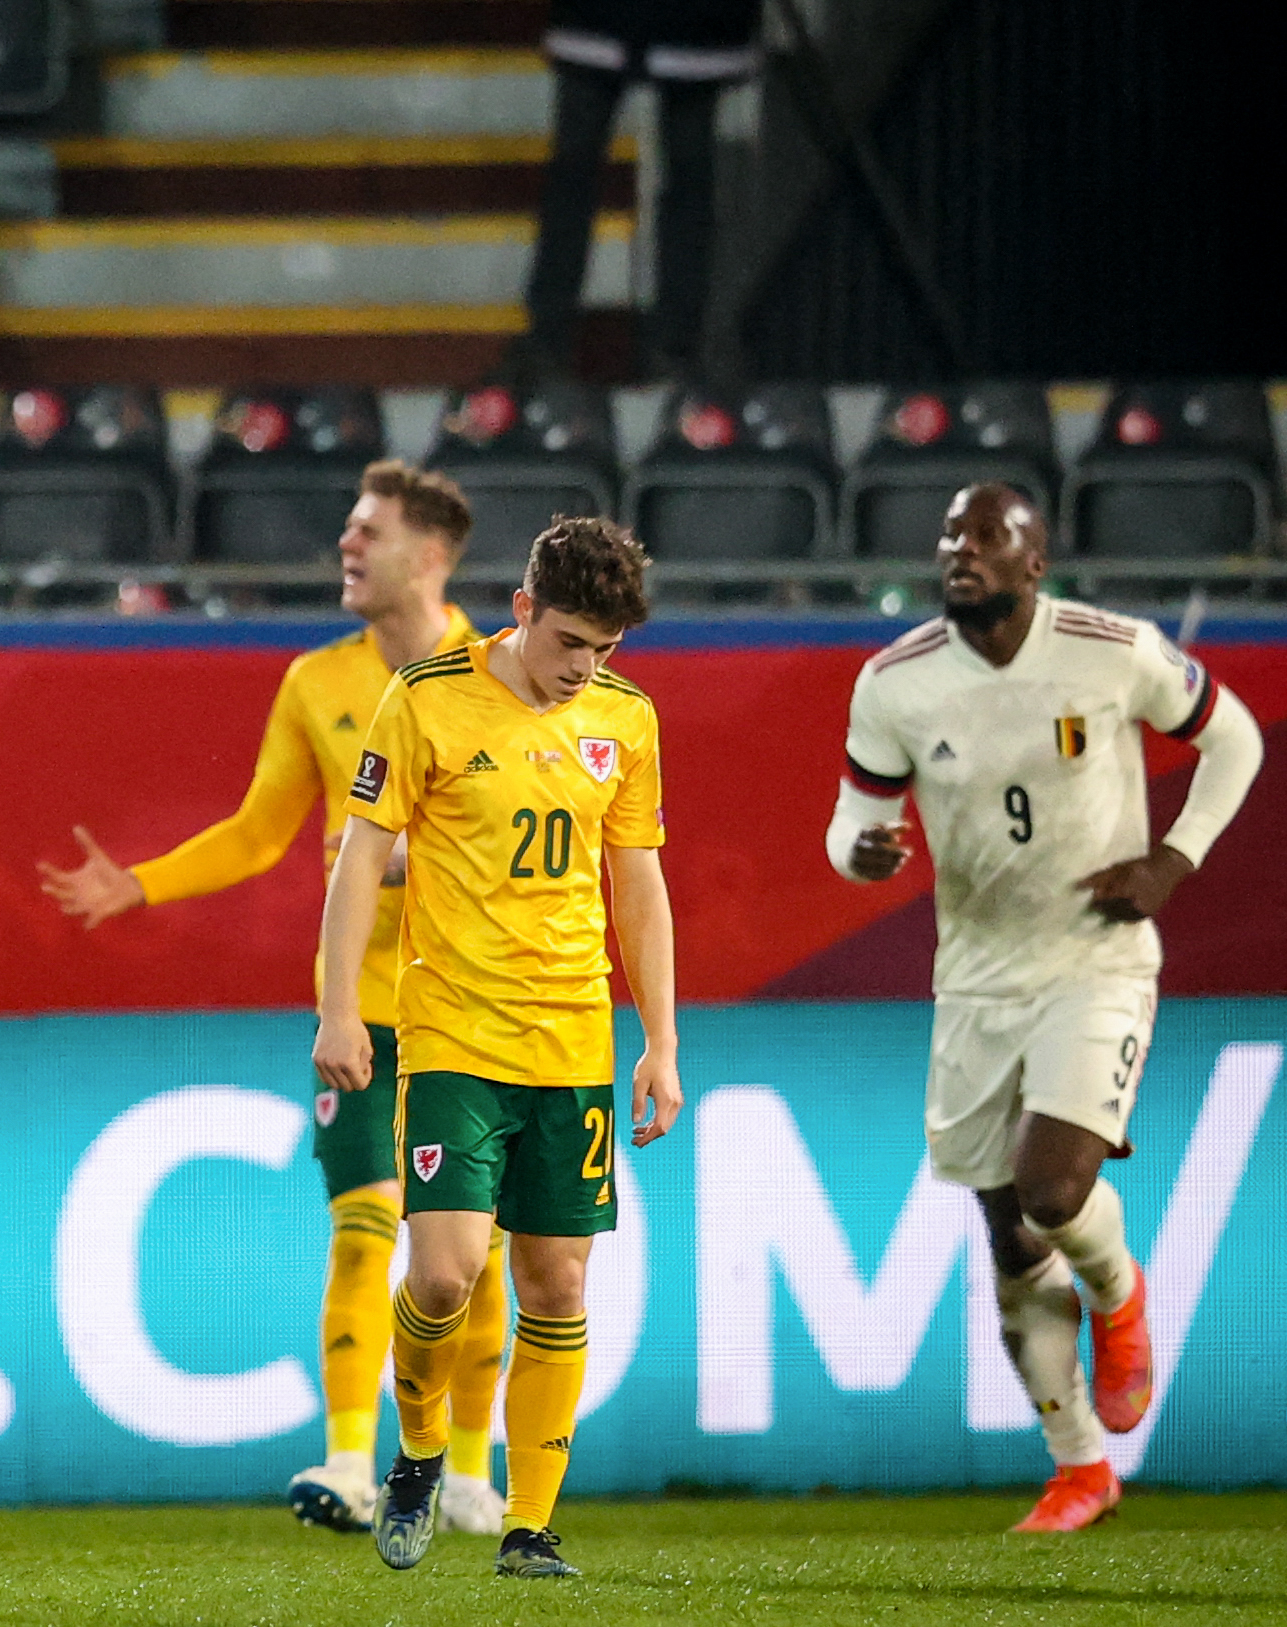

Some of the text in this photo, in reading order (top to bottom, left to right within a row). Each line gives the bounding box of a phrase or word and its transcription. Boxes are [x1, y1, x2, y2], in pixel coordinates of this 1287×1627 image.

[510, 808, 572, 878] 20
[1004, 785, 1032, 844] 9
[1113, 1033, 1138, 1090] 9
[581, 1106, 612, 1179] 2
